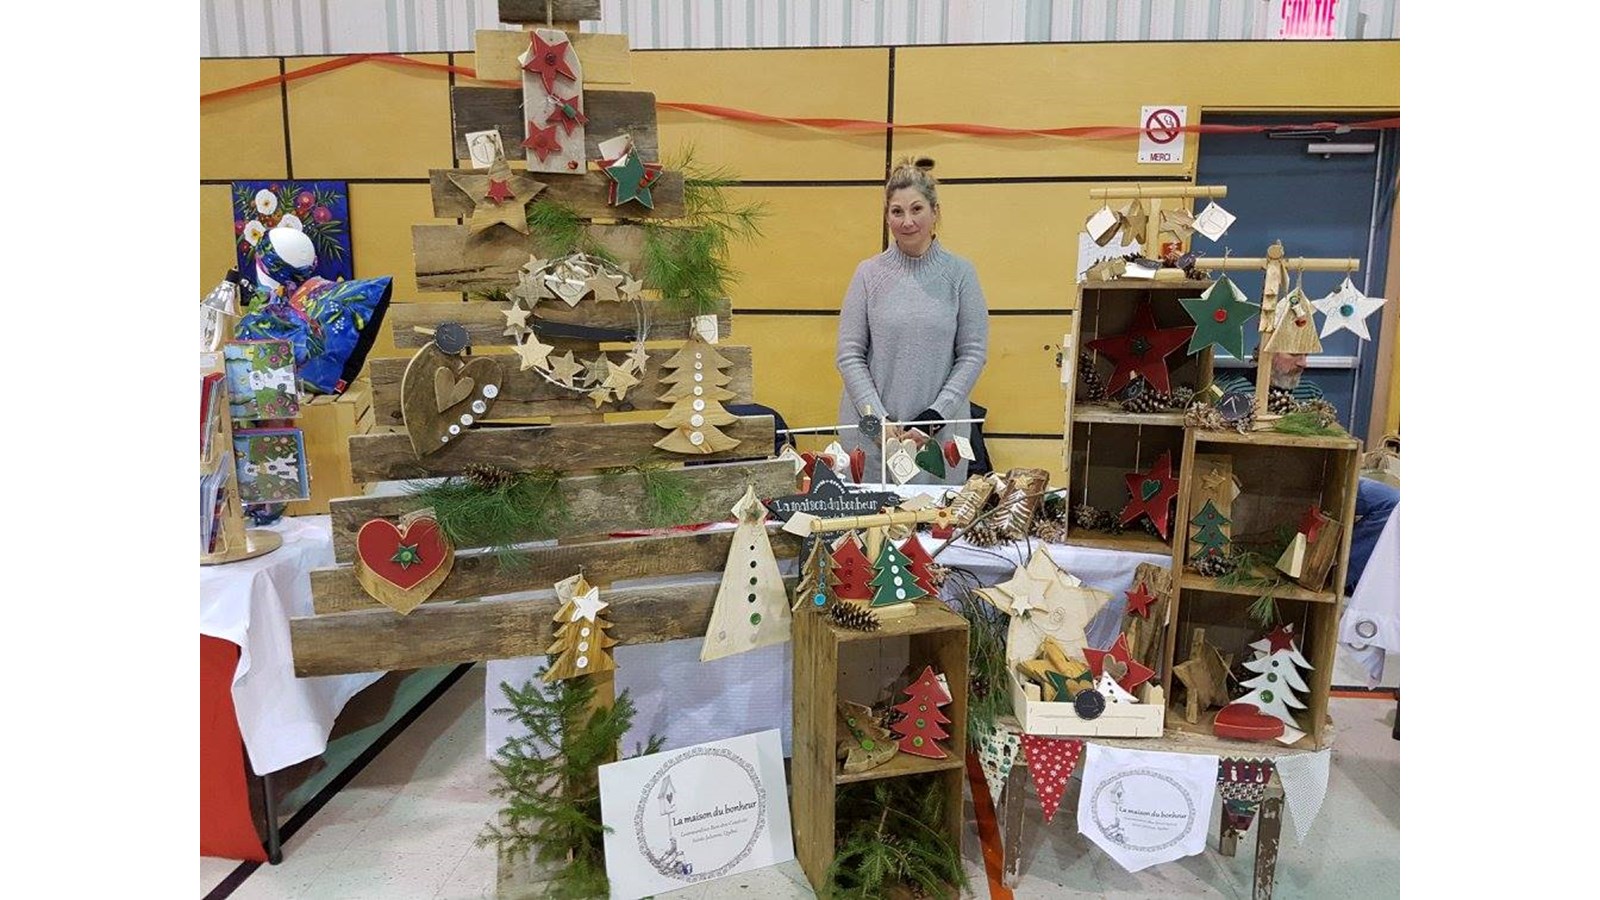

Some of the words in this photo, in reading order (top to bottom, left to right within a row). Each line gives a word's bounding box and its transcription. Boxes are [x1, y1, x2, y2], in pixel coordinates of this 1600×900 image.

[1150, 153, 1171, 161] MERCI
[838, 495, 879, 510] bonheur
[672, 817, 684, 827] La
[684, 811, 713, 823] maison
[712, 806, 725, 817] du
[725, 800, 757, 815] bonheur
